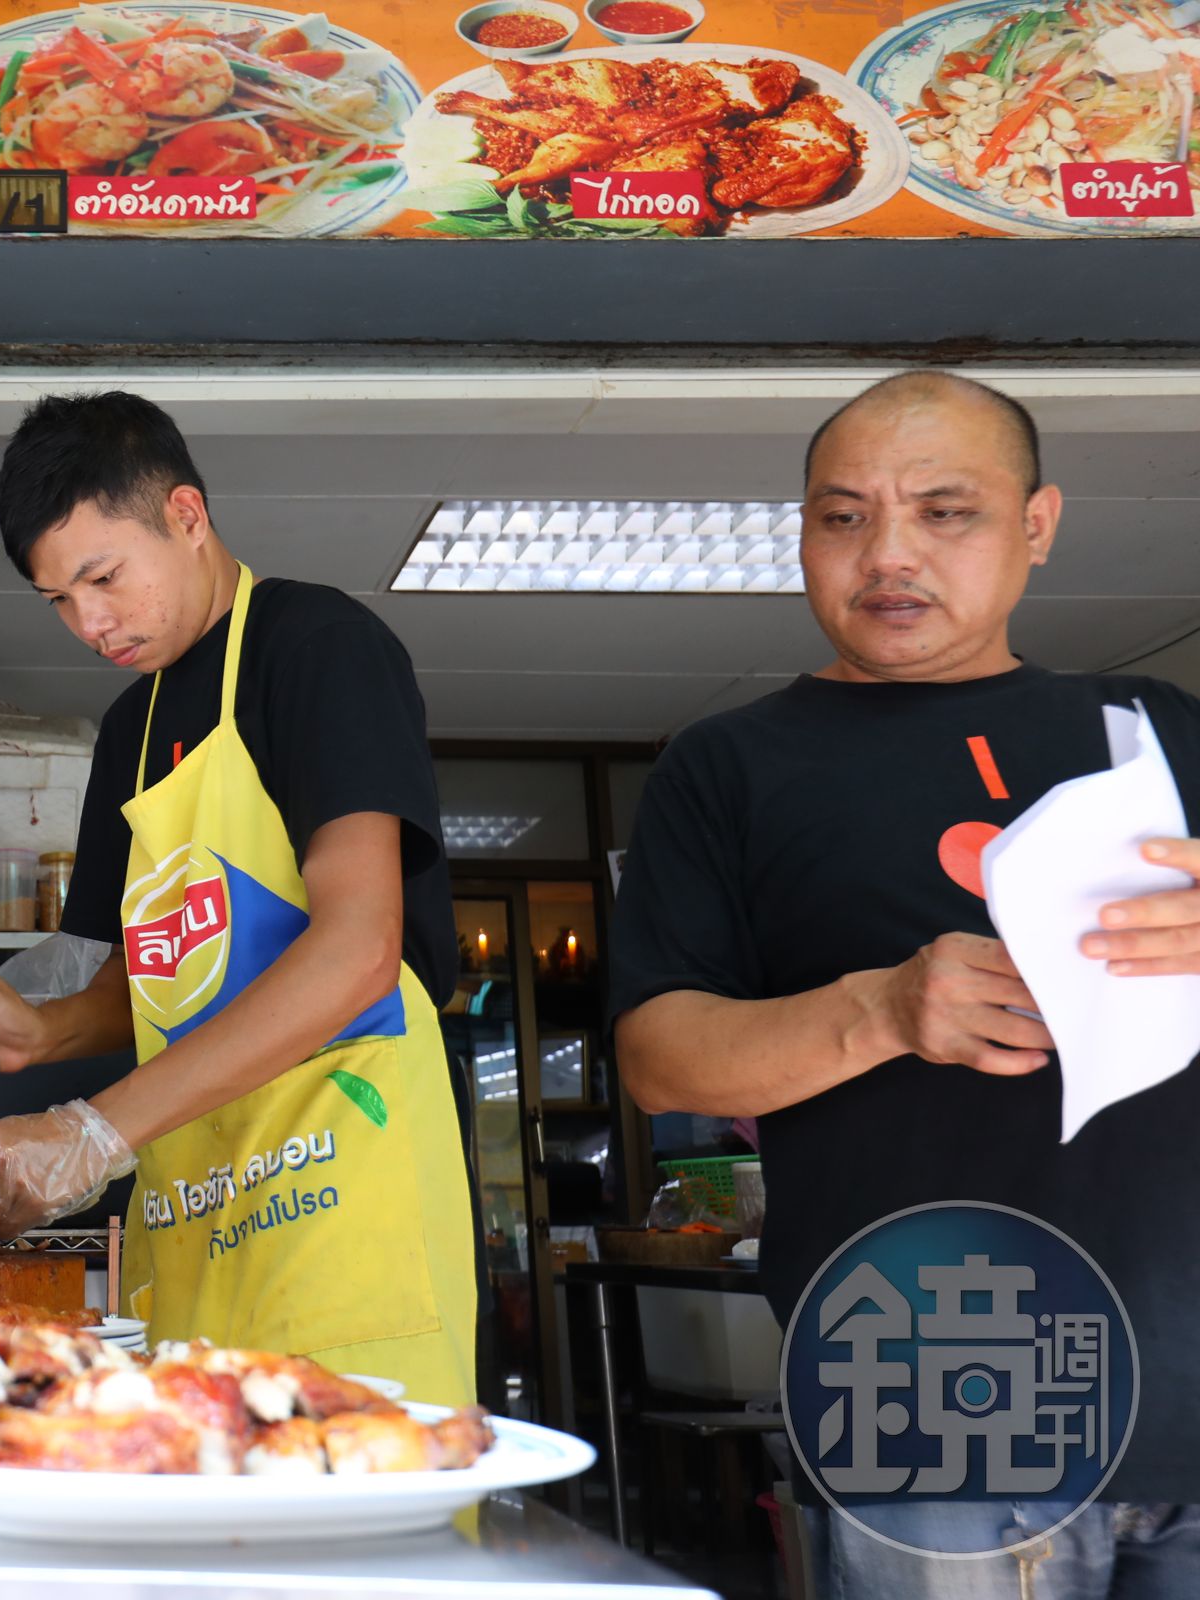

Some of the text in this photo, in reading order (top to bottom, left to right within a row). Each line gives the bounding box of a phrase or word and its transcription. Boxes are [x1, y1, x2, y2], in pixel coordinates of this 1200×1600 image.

[74, 179, 251, 217] ตำอันดามัน
[573, 176, 700, 215] ไก่ทอด
[1071, 164, 1183, 213] ตำปูม้า
